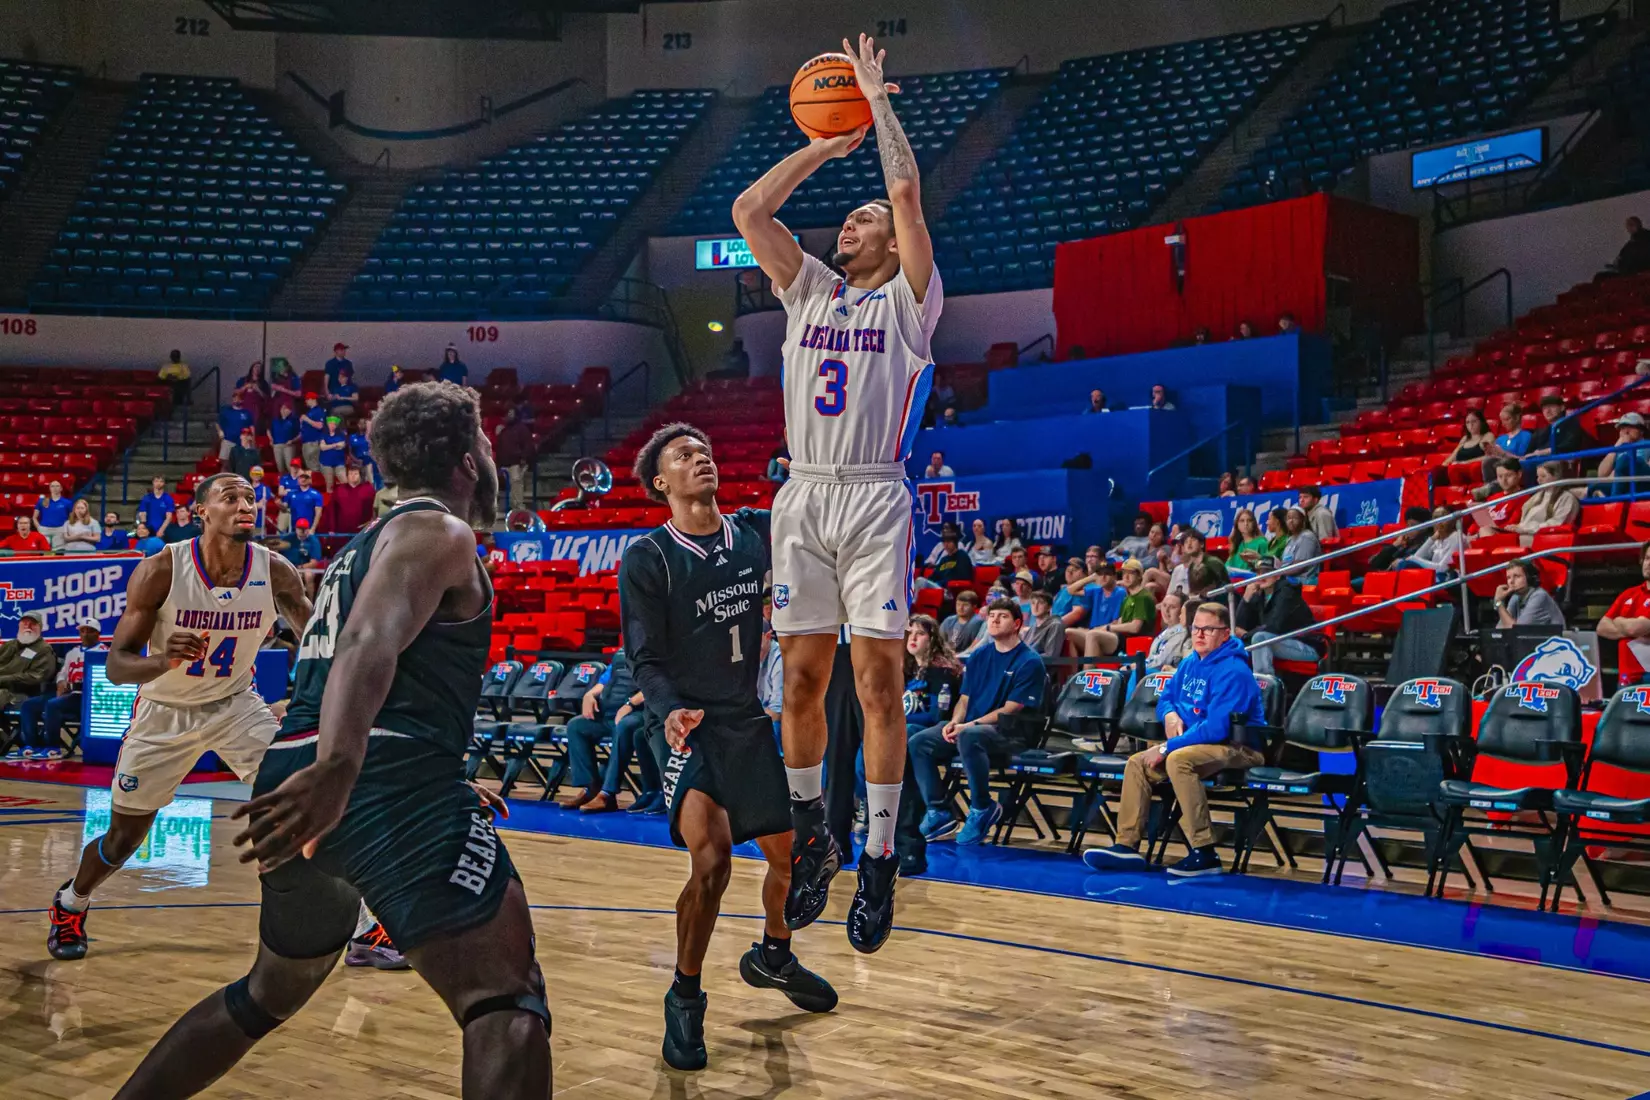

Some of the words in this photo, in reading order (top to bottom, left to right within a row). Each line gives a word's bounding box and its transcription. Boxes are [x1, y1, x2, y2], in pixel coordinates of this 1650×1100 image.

[175, 16, 209, 36] 212
[877, 18, 907, 37] 214
[662, 32, 692, 49] 213
[813, 75, 856, 91] NCAA
[0, 318, 37, 336] 108
[467, 326, 499, 342] 109
[854, 328, 885, 353] TECH
[814, 358, 849, 416] 3
[917, 482, 980, 524] TECH
[995, 515, 1066, 541] STION
[550, 534, 643, 577] KENN
[0, 581, 35, 601] ECH
[44, 565, 122, 602] HOOP
[695, 580, 758, 618] Missouri
[713, 599, 751, 623] State
[175, 609, 234, 631] LOUISIANA
[237, 610, 262, 631] TECH
[185, 635, 238, 678] 14
[729, 625, 744, 663] 1
[448, 812, 497, 895] BEARS
